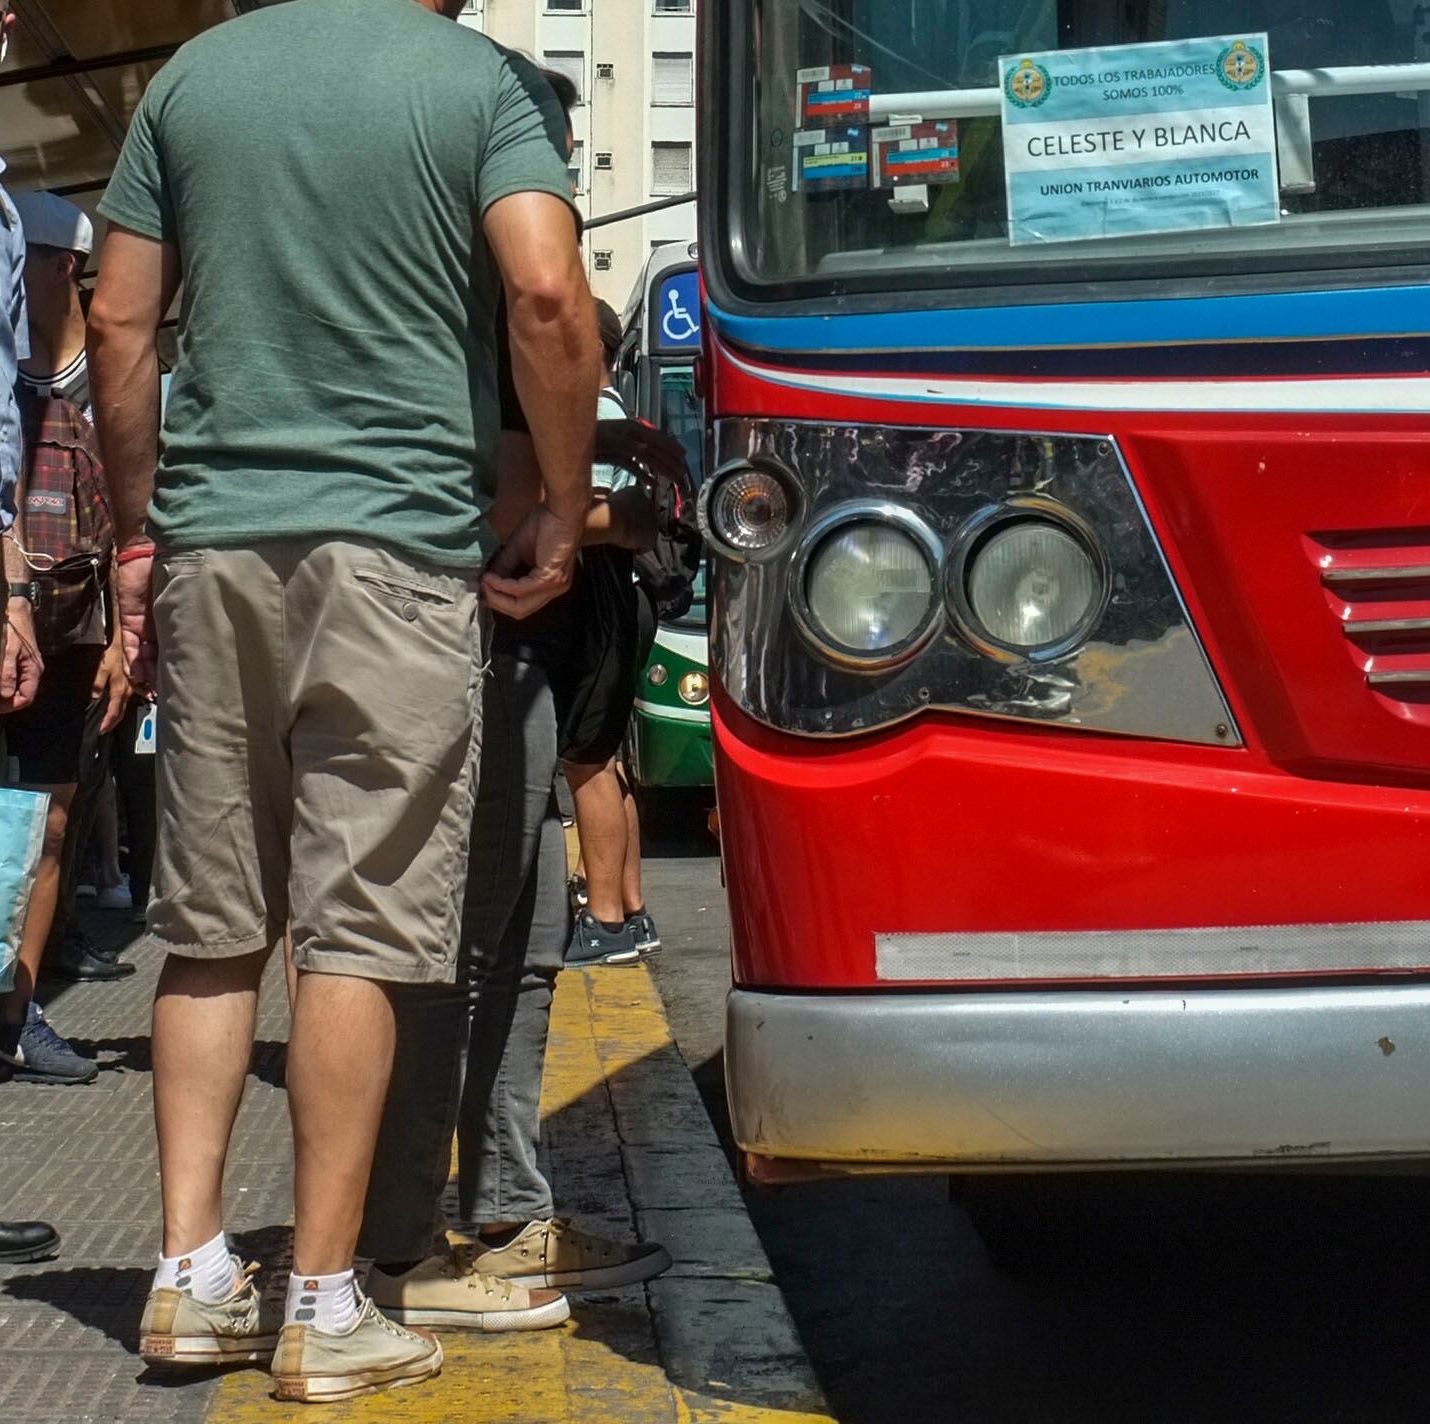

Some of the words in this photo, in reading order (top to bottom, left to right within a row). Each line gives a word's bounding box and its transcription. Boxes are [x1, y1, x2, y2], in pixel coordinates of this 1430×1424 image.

[1054, 73, 1095, 87] TODOS
[1097, 70, 1120, 84] LOS
[1122, 63, 1217, 82] TRABAJADORES
[1102, 88, 1149, 102] SOMOS
[1151, 84, 1184, 98] 100%
[1027, 130, 1125, 157] CELESTE
[1132, 128, 1146, 149] Y
[1154, 120, 1251, 147] BLANCA
[1040, 181, 1083, 196] UNION
[1086, 177, 1172, 193] TRANVIARIOS
[1174, 168, 1260, 186] AUTOMOTOR
